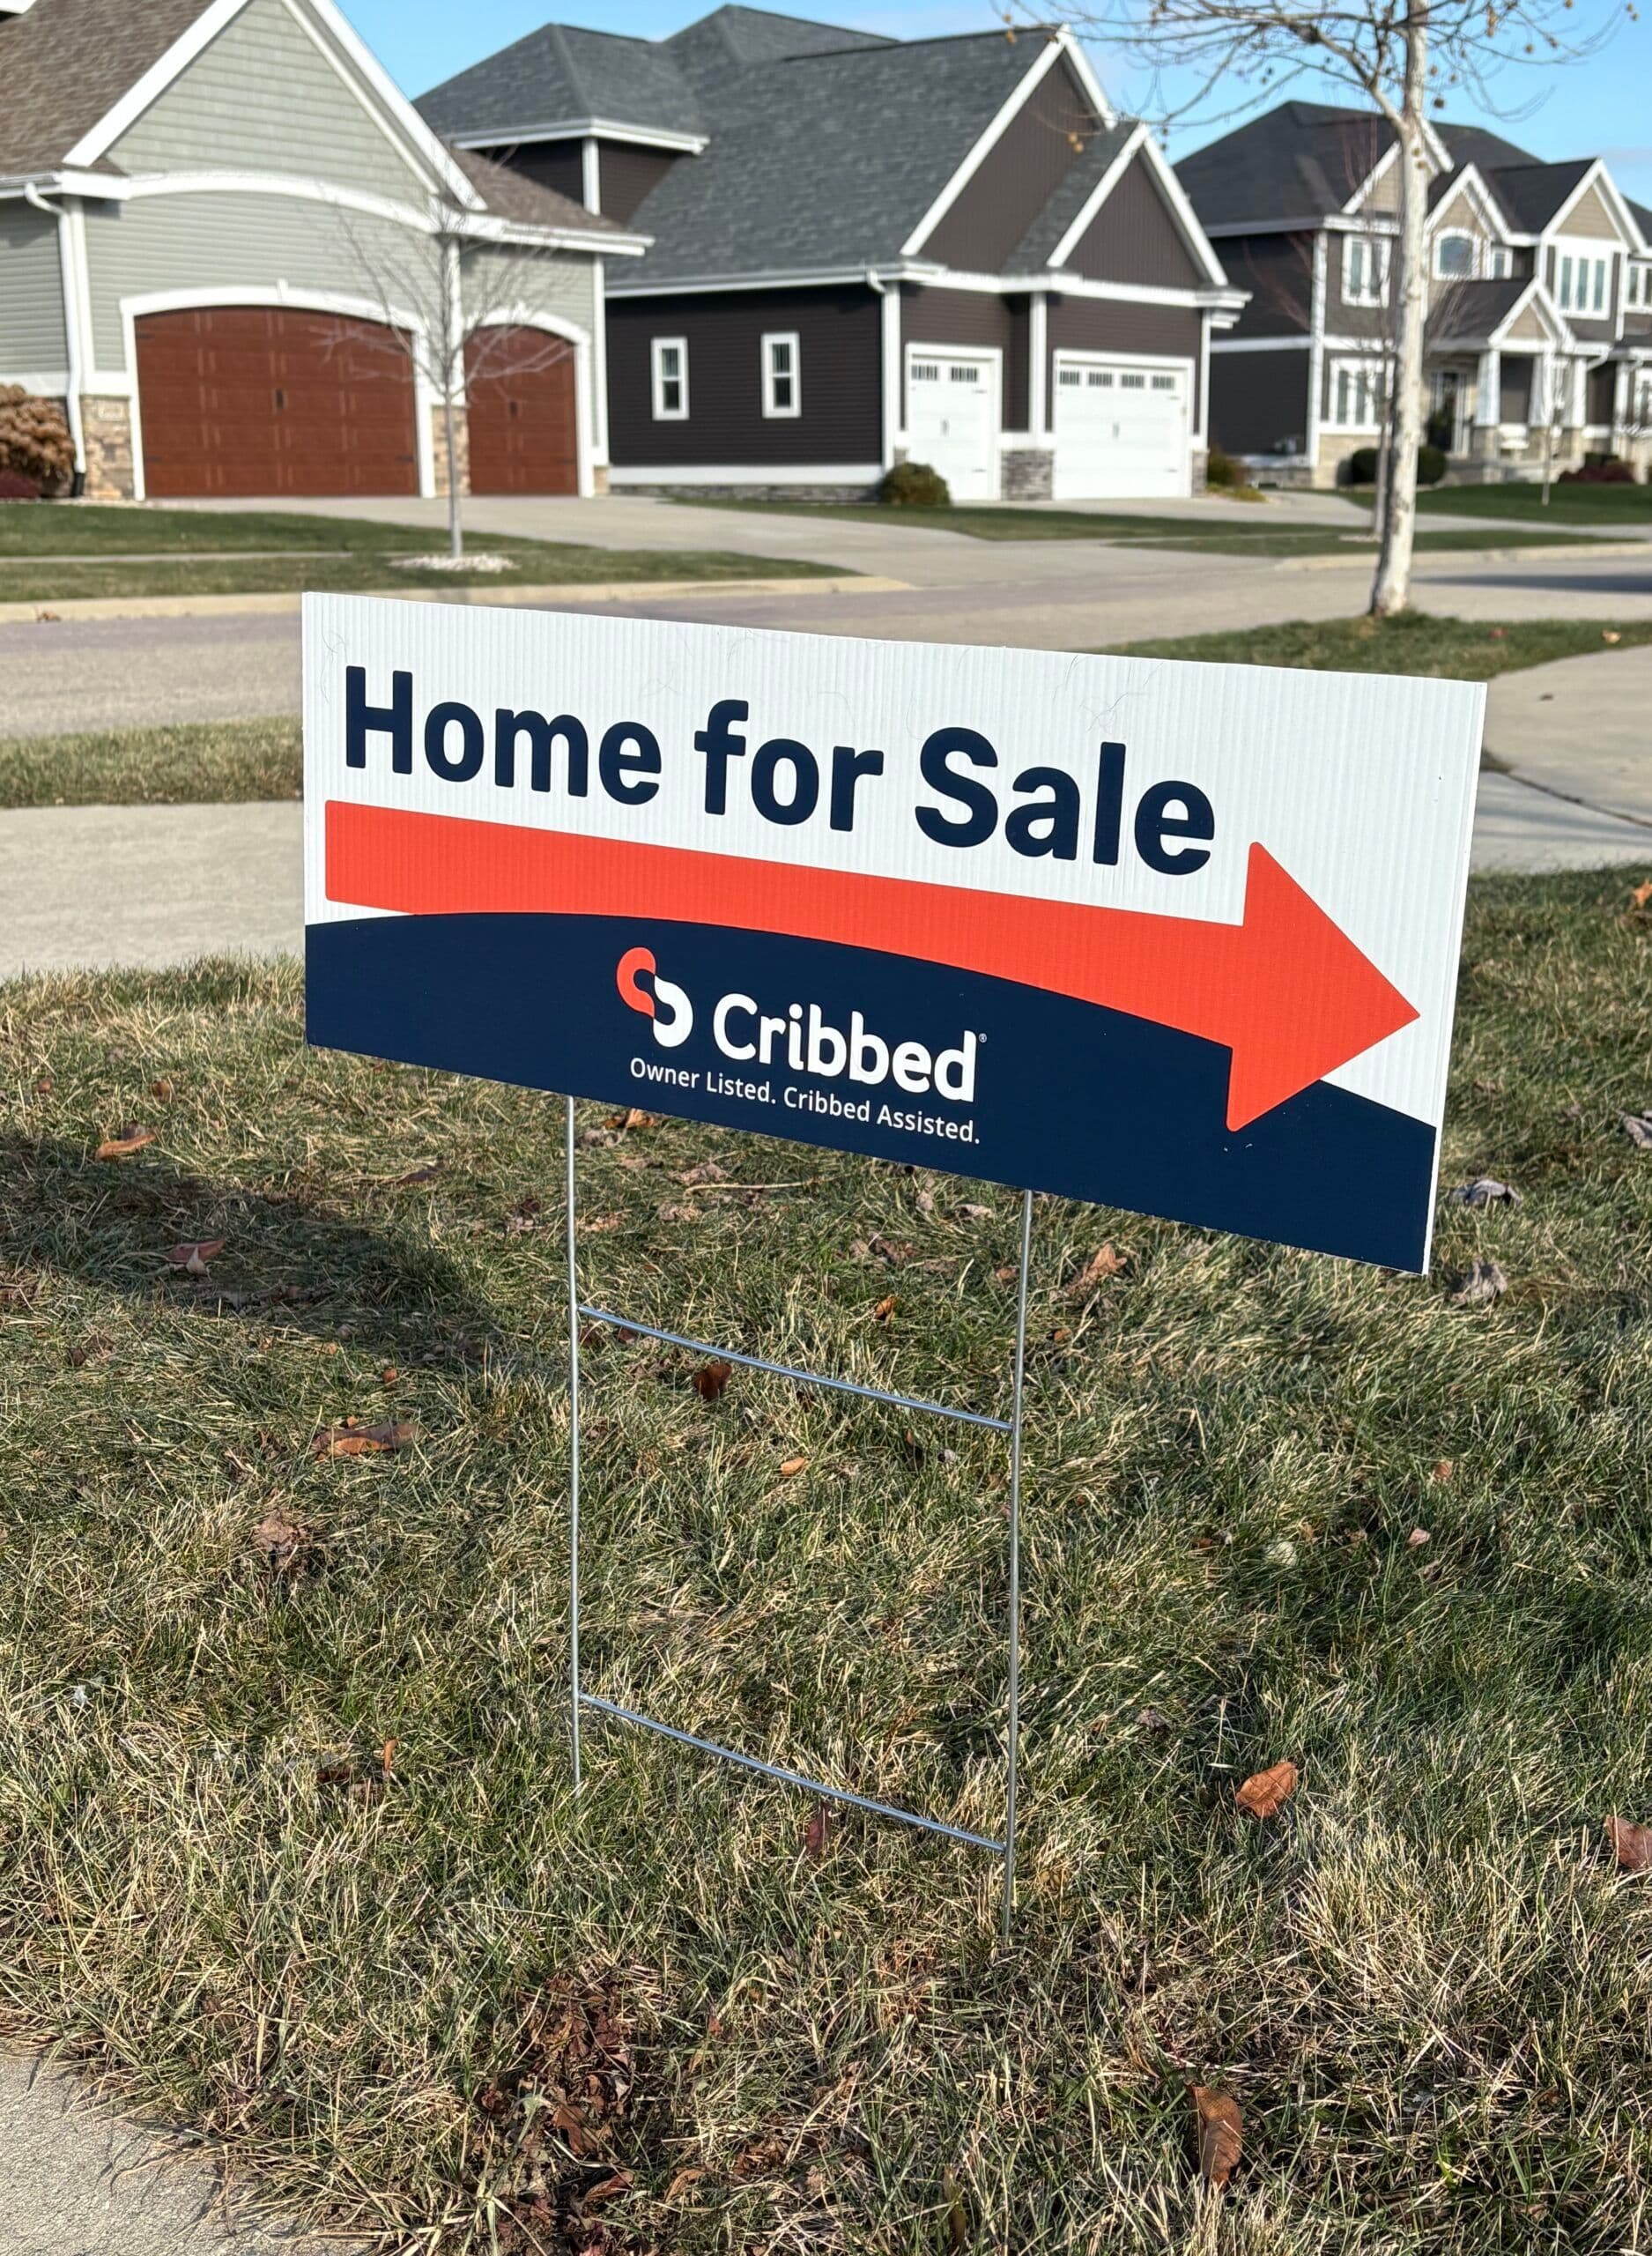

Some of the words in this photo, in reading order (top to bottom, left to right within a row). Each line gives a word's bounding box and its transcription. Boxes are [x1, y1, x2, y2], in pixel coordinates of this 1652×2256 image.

[345, 665, 662, 805] Home
[693, 699, 885, 832] for
[915, 726, 1215, 876] Sale
[630, 1057, 700, 1088] Owner
[706, 1071, 776, 1104] Listed.
[783, 1086, 870, 1123] Cribbed
[876, 1104, 980, 1145] Assisted.
